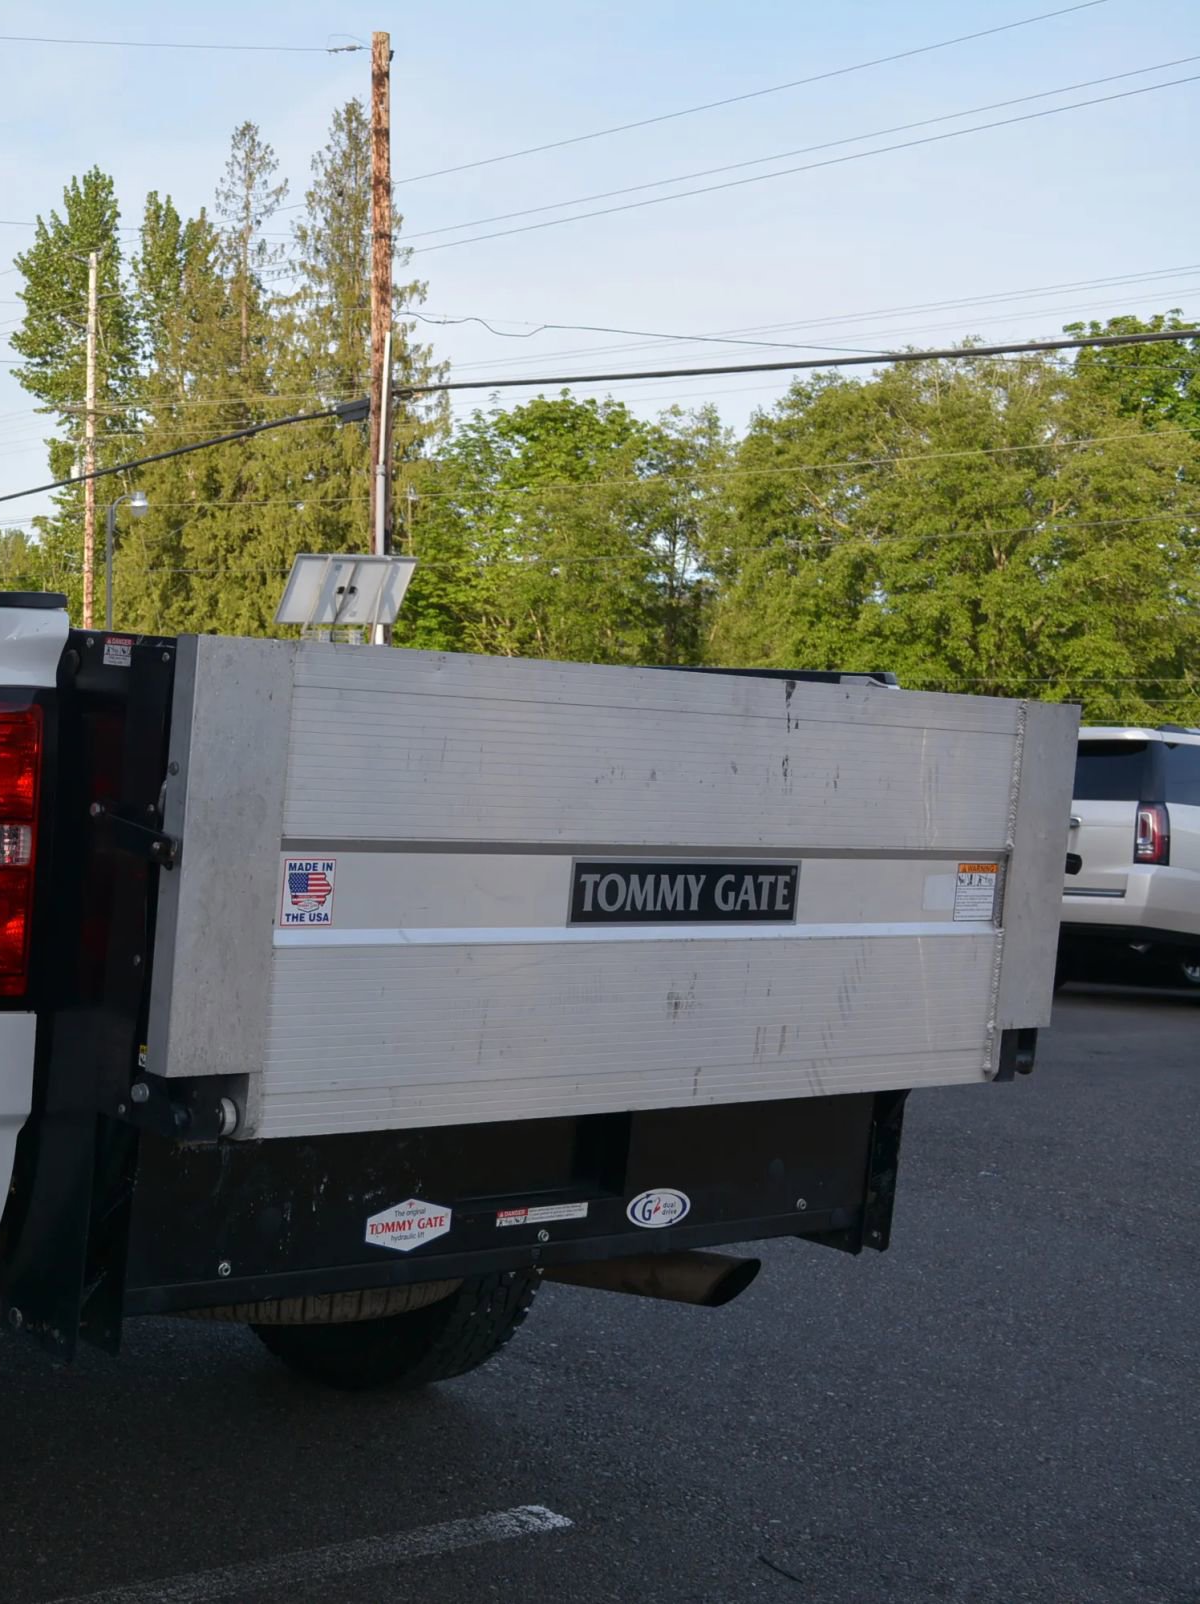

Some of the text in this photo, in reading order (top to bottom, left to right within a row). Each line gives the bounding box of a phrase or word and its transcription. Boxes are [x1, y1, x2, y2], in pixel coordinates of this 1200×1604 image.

[288, 862, 333, 872] MADE IN
[968, 865, 995, 873] WARNING
[580, 873, 790, 912] TOMMY GATE
[285, 913, 329, 922] THE USA
[406, 1208, 426, 1217] original
[369, 1216, 445, 1235] TOMMY GATE
